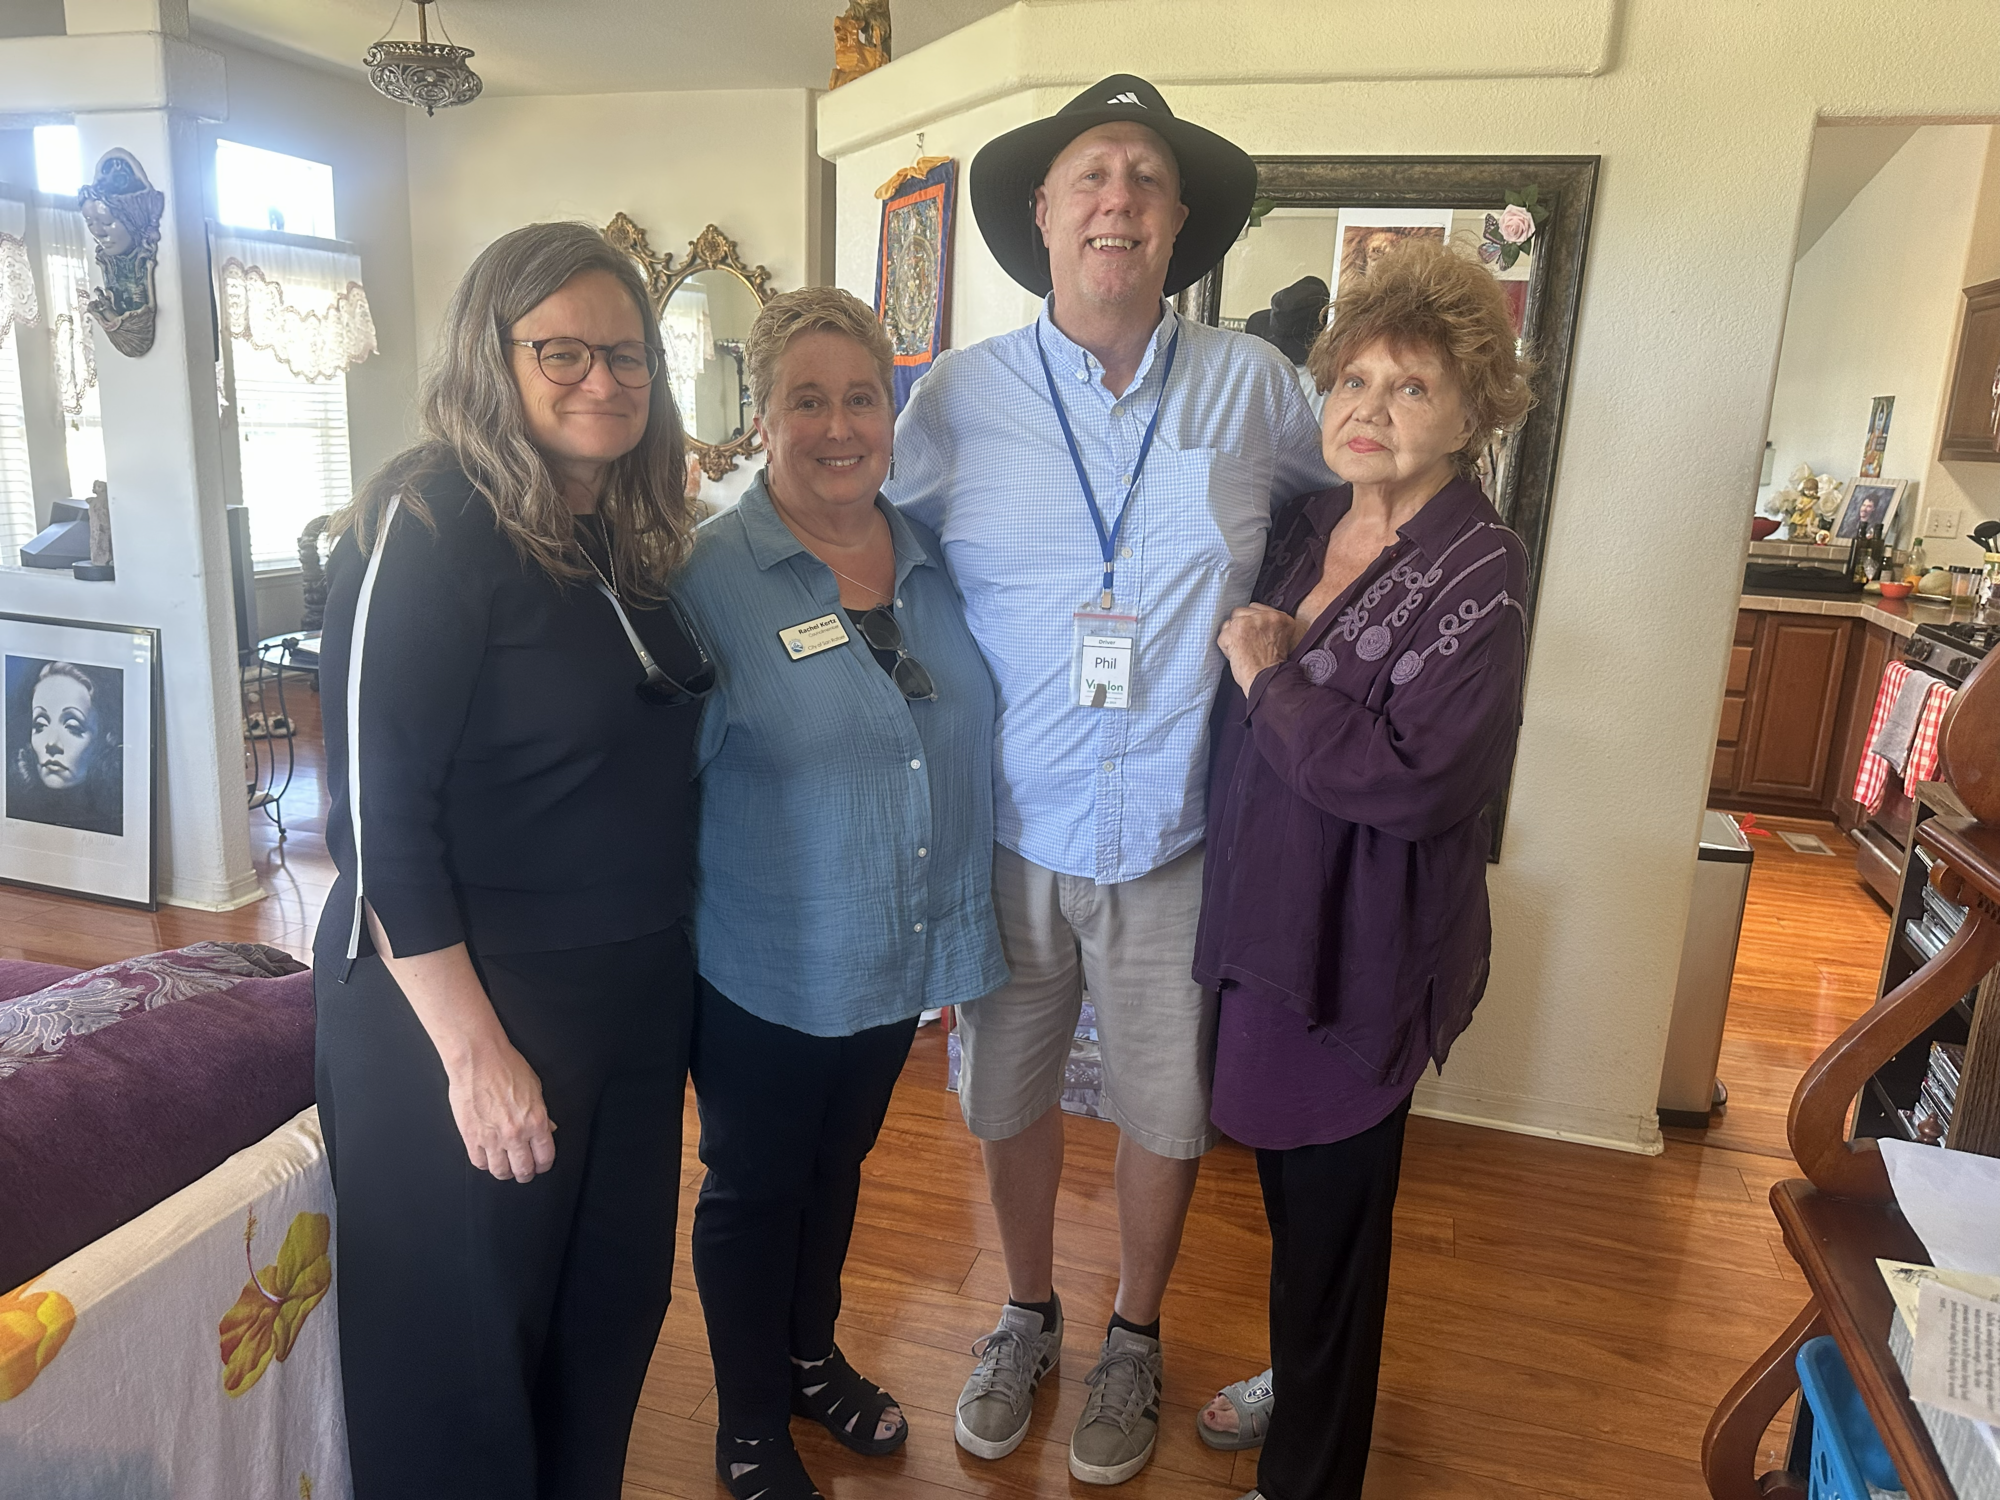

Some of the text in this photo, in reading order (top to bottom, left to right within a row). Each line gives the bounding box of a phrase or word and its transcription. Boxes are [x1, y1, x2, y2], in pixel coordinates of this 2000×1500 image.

[798, 618, 837, 635] Rachel Kertz
[1094, 657, 1117, 670] Phil
[1085, 678, 1124, 691] Vilon
